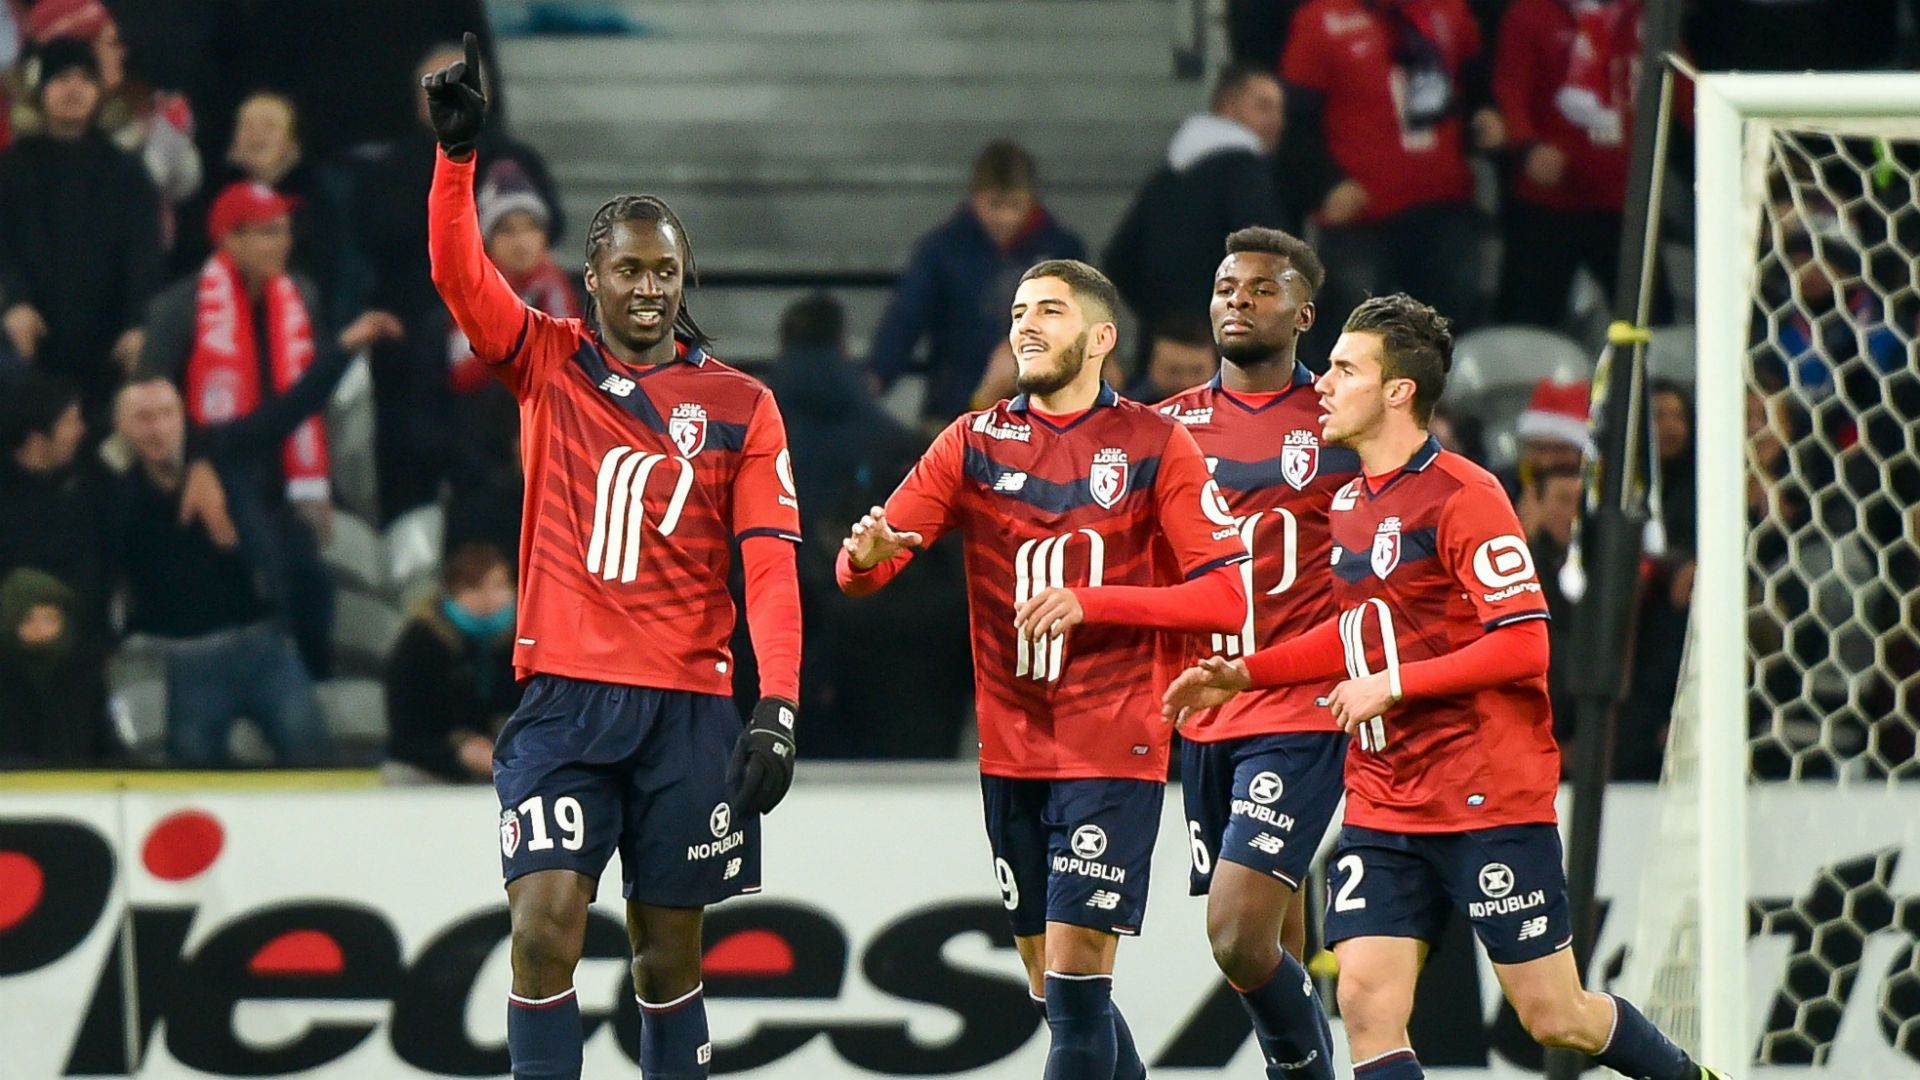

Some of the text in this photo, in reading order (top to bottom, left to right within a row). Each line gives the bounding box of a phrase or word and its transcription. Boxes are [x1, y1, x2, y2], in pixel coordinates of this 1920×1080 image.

[672, 407, 707, 418] LOSC
[1093, 453, 1128, 463] LOSC
[1284, 435, 1319, 445] LOSC
[517, 796, 584, 851] 19
[1189, 820, 1211, 874] 6
[996, 857, 1019, 910] 9
[1335, 854, 1366, 912] 2
